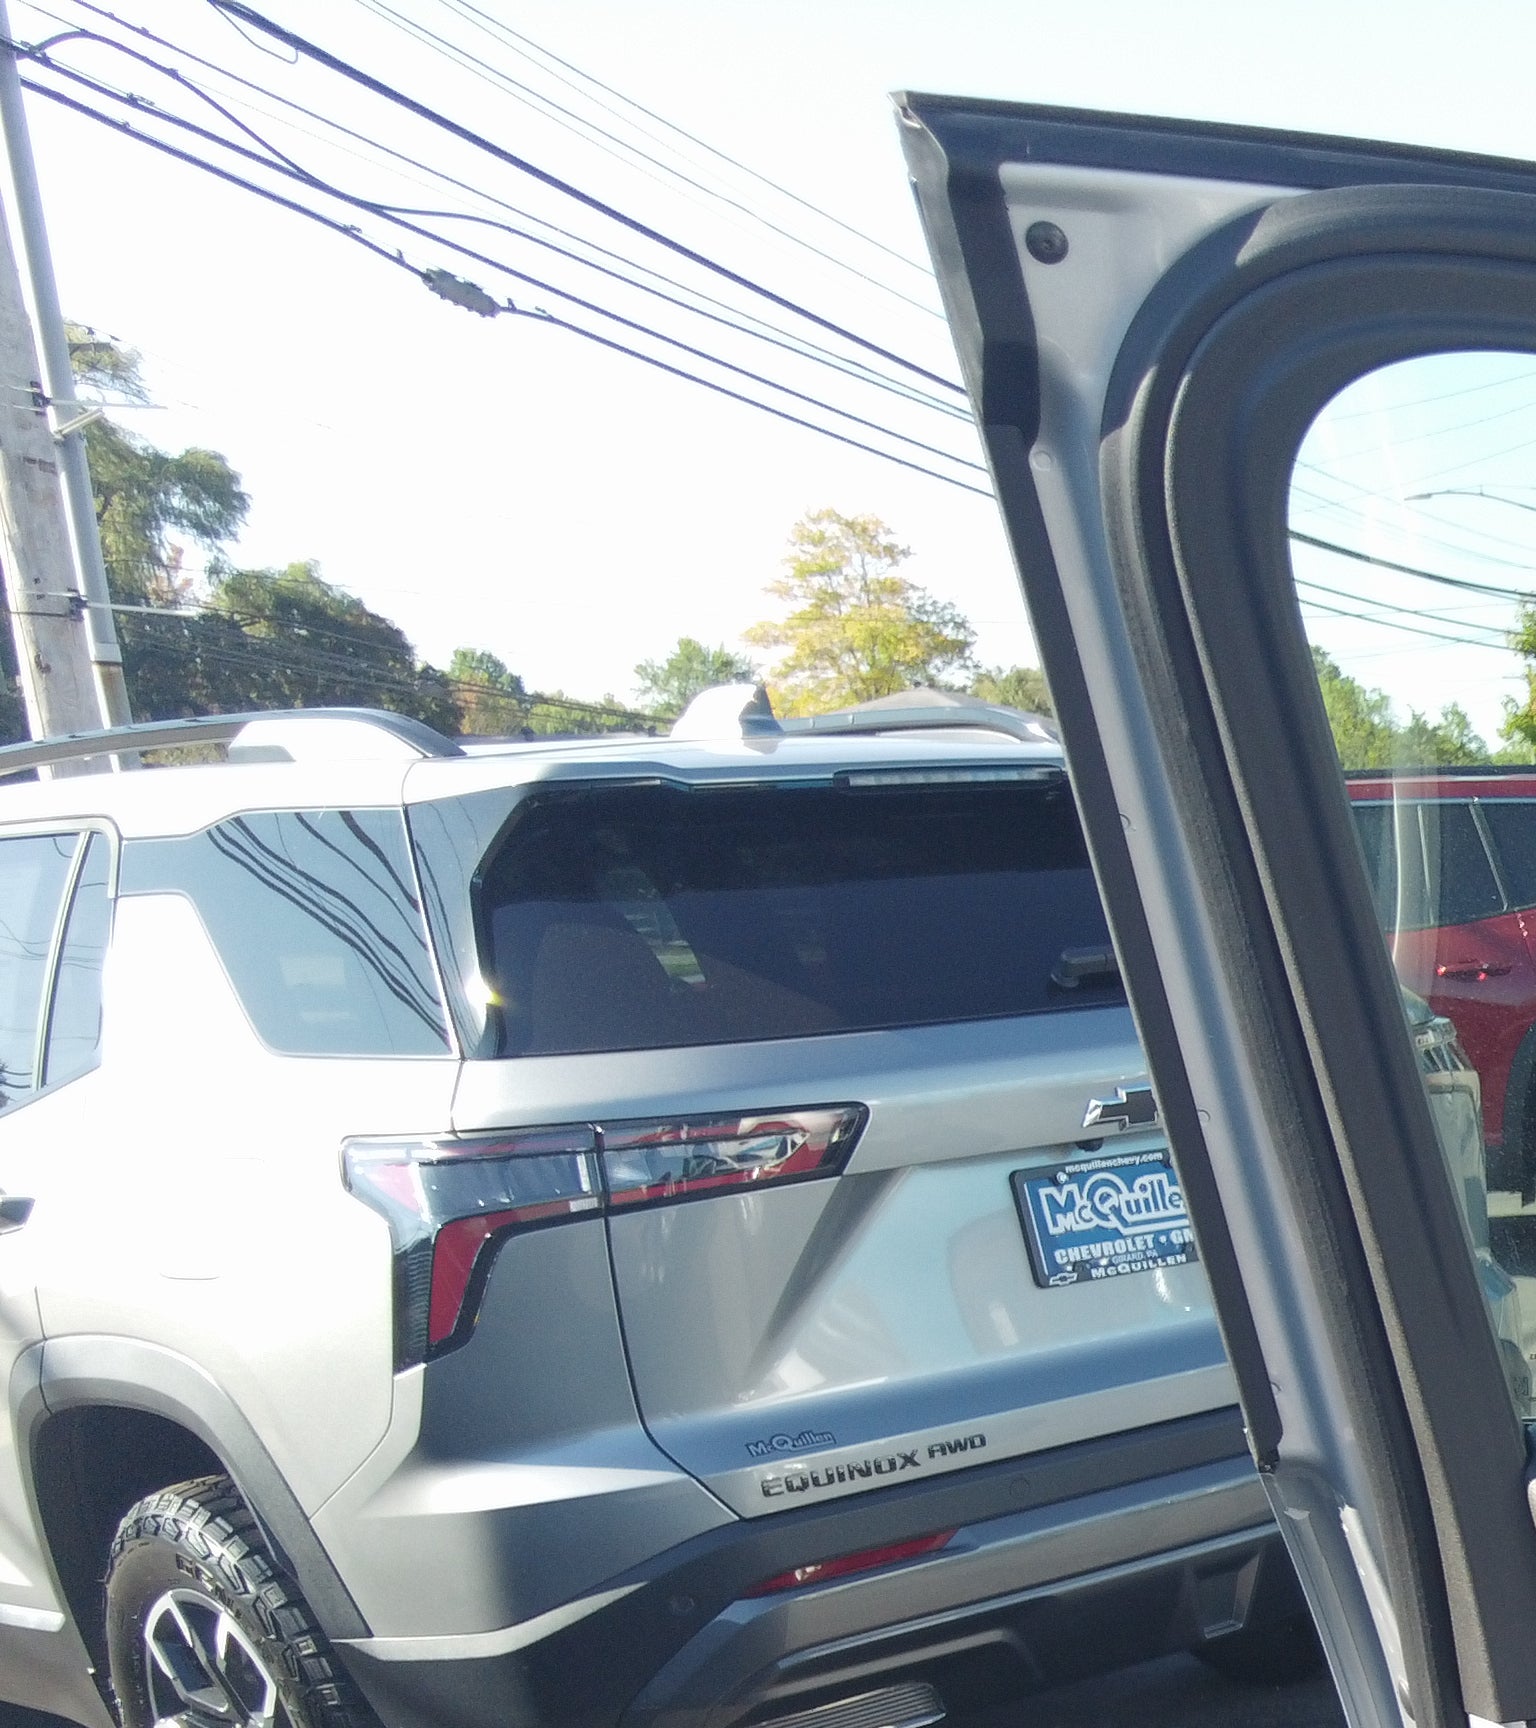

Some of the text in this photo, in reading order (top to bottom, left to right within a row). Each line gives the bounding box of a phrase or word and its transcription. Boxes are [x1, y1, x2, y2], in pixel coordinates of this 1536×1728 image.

[1065, 1152, 1163, 1174] mcquillenchevy.com
[1039, 1172, 1188, 1236] McQuille
[1054, 1234, 1154, 1265] CHEVROLET
[746, 1430, 838, 1458] McQuillen
[760, 1433, 987, 1498] EQUINOX AWD
